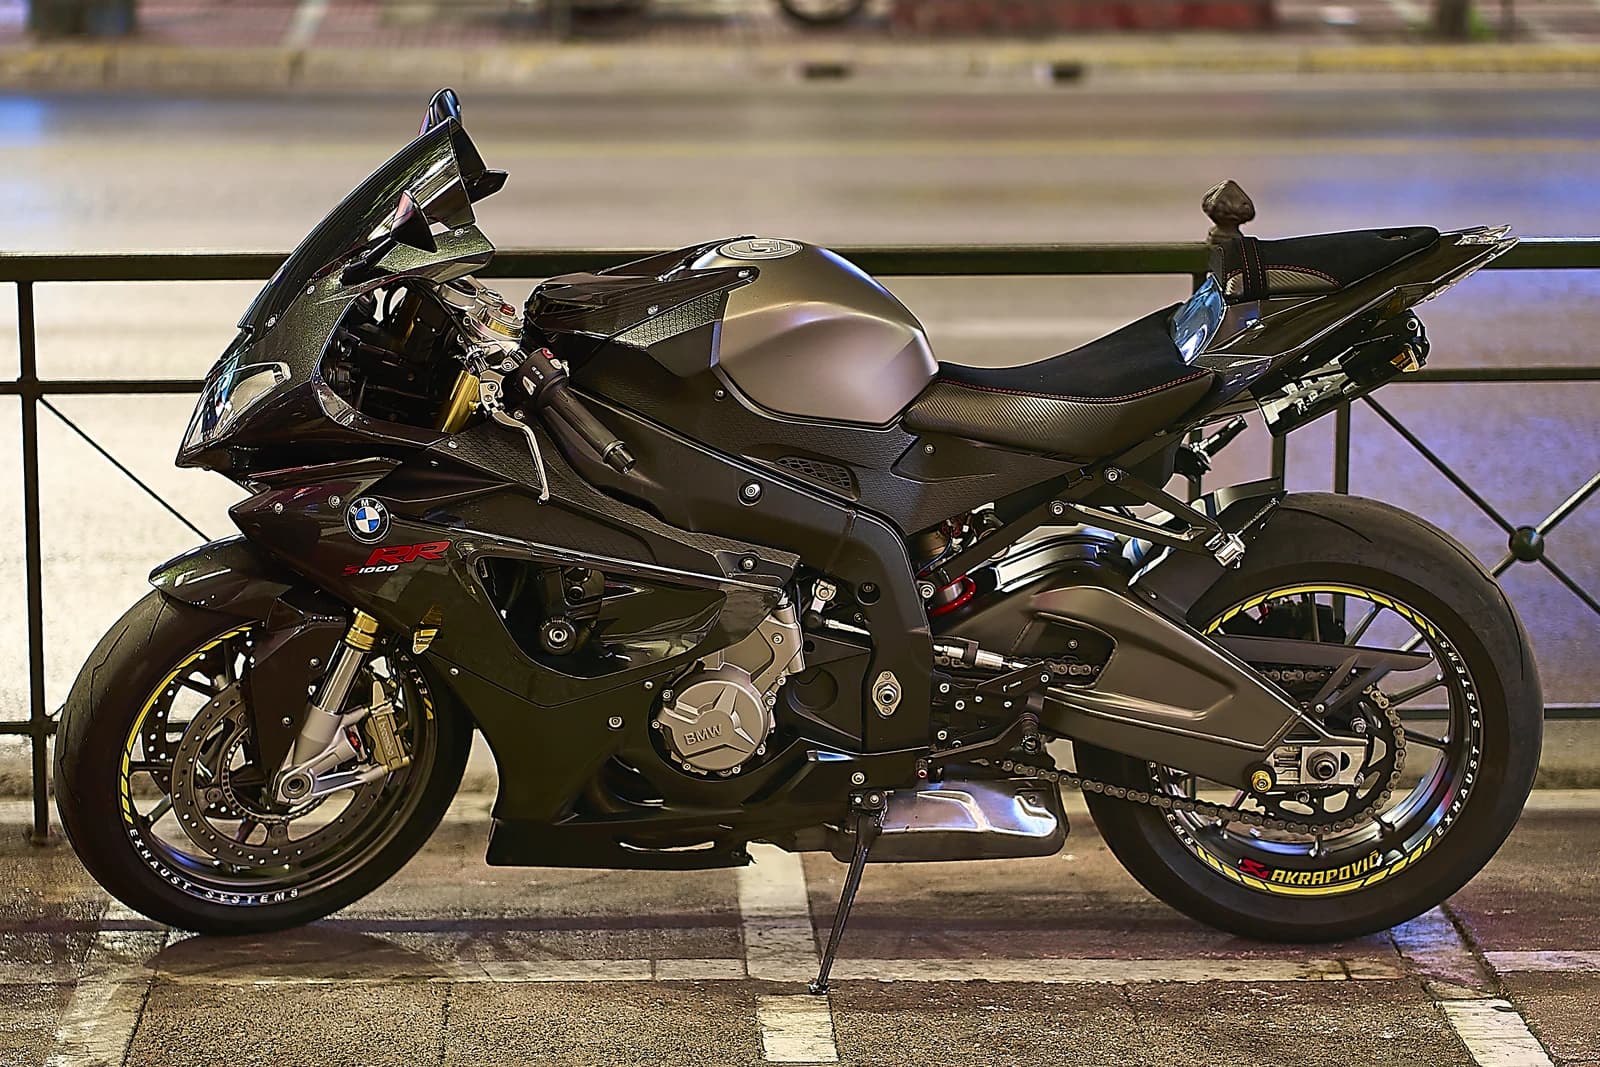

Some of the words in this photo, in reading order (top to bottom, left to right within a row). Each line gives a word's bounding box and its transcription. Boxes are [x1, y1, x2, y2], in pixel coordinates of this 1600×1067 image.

[364, 540, 451, 566] RR
[1439, 640, 1481, 728] SYSTEMS
[683, 723, 722, 745] BMW
[1435, 748, 1480, 837] EXHAUST
[129, 827, 192, 891] EXHAUST
